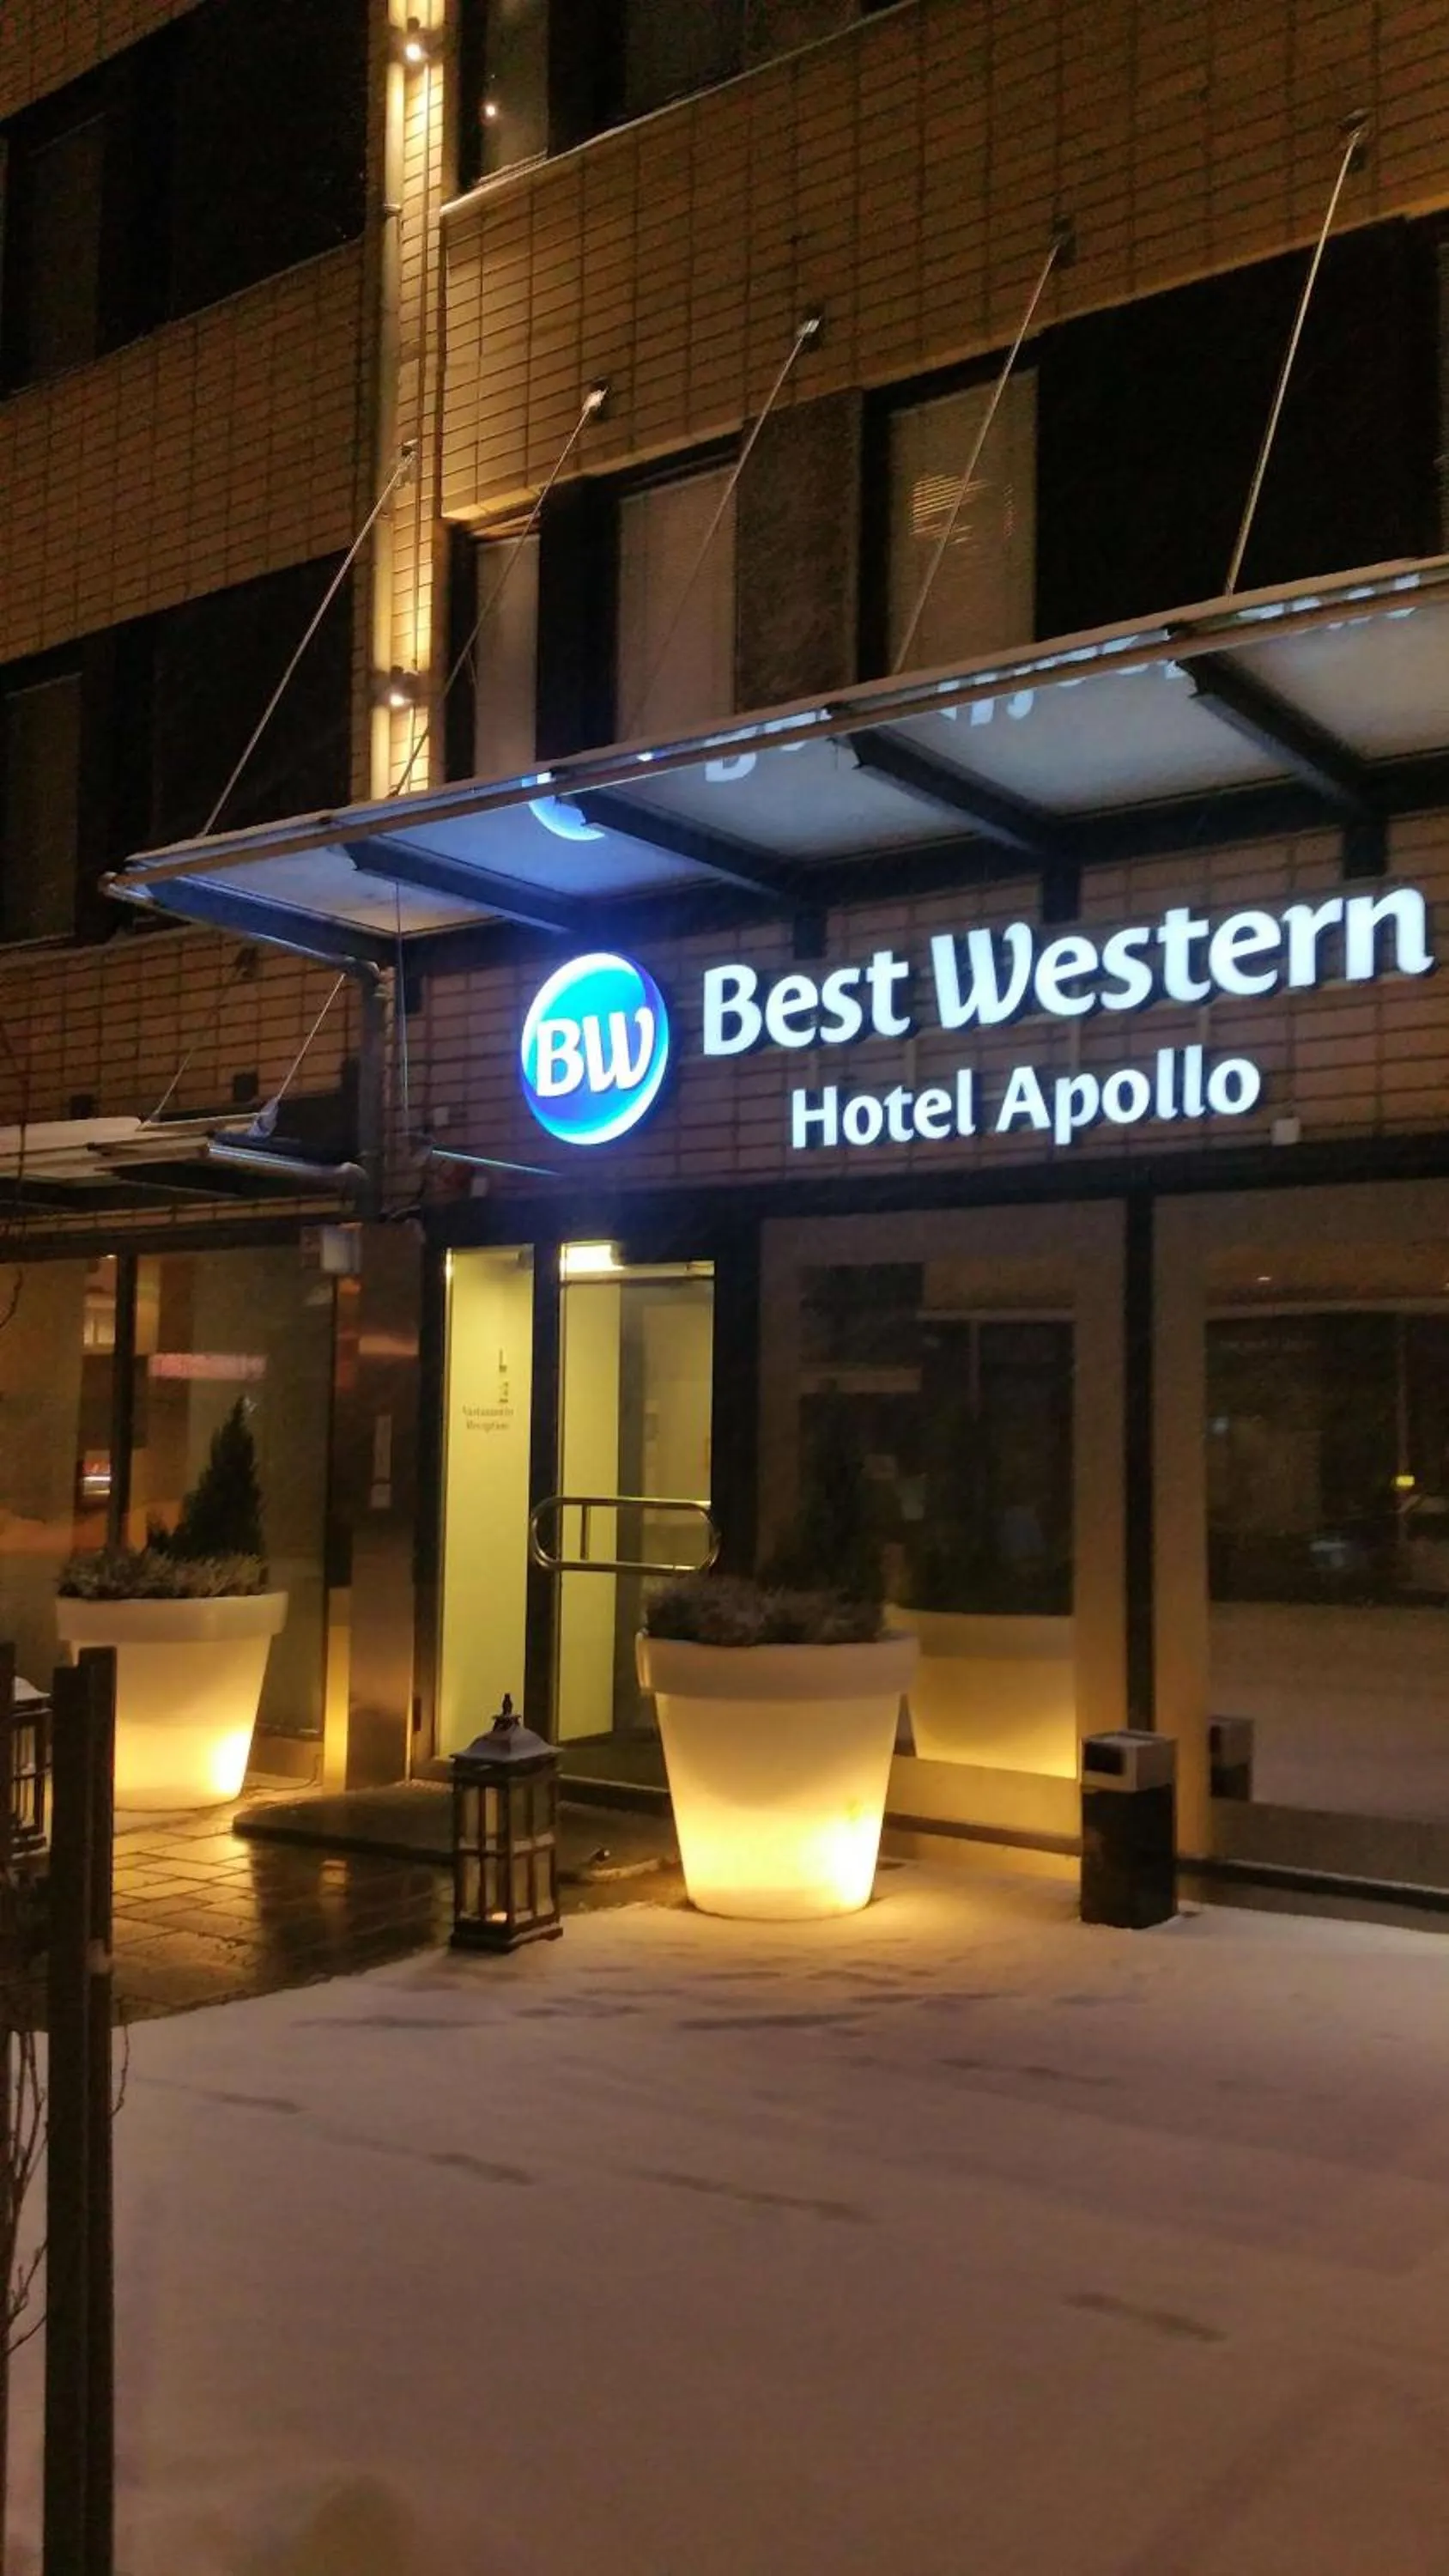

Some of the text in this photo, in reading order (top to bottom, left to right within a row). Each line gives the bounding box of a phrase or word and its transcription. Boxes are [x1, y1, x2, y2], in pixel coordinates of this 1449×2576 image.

[703, 888, 1434, 1056] Best Western
[537, 1007, 656, 1098] BW
[791, 1044, 1261, 1149] Hotel Apollo
